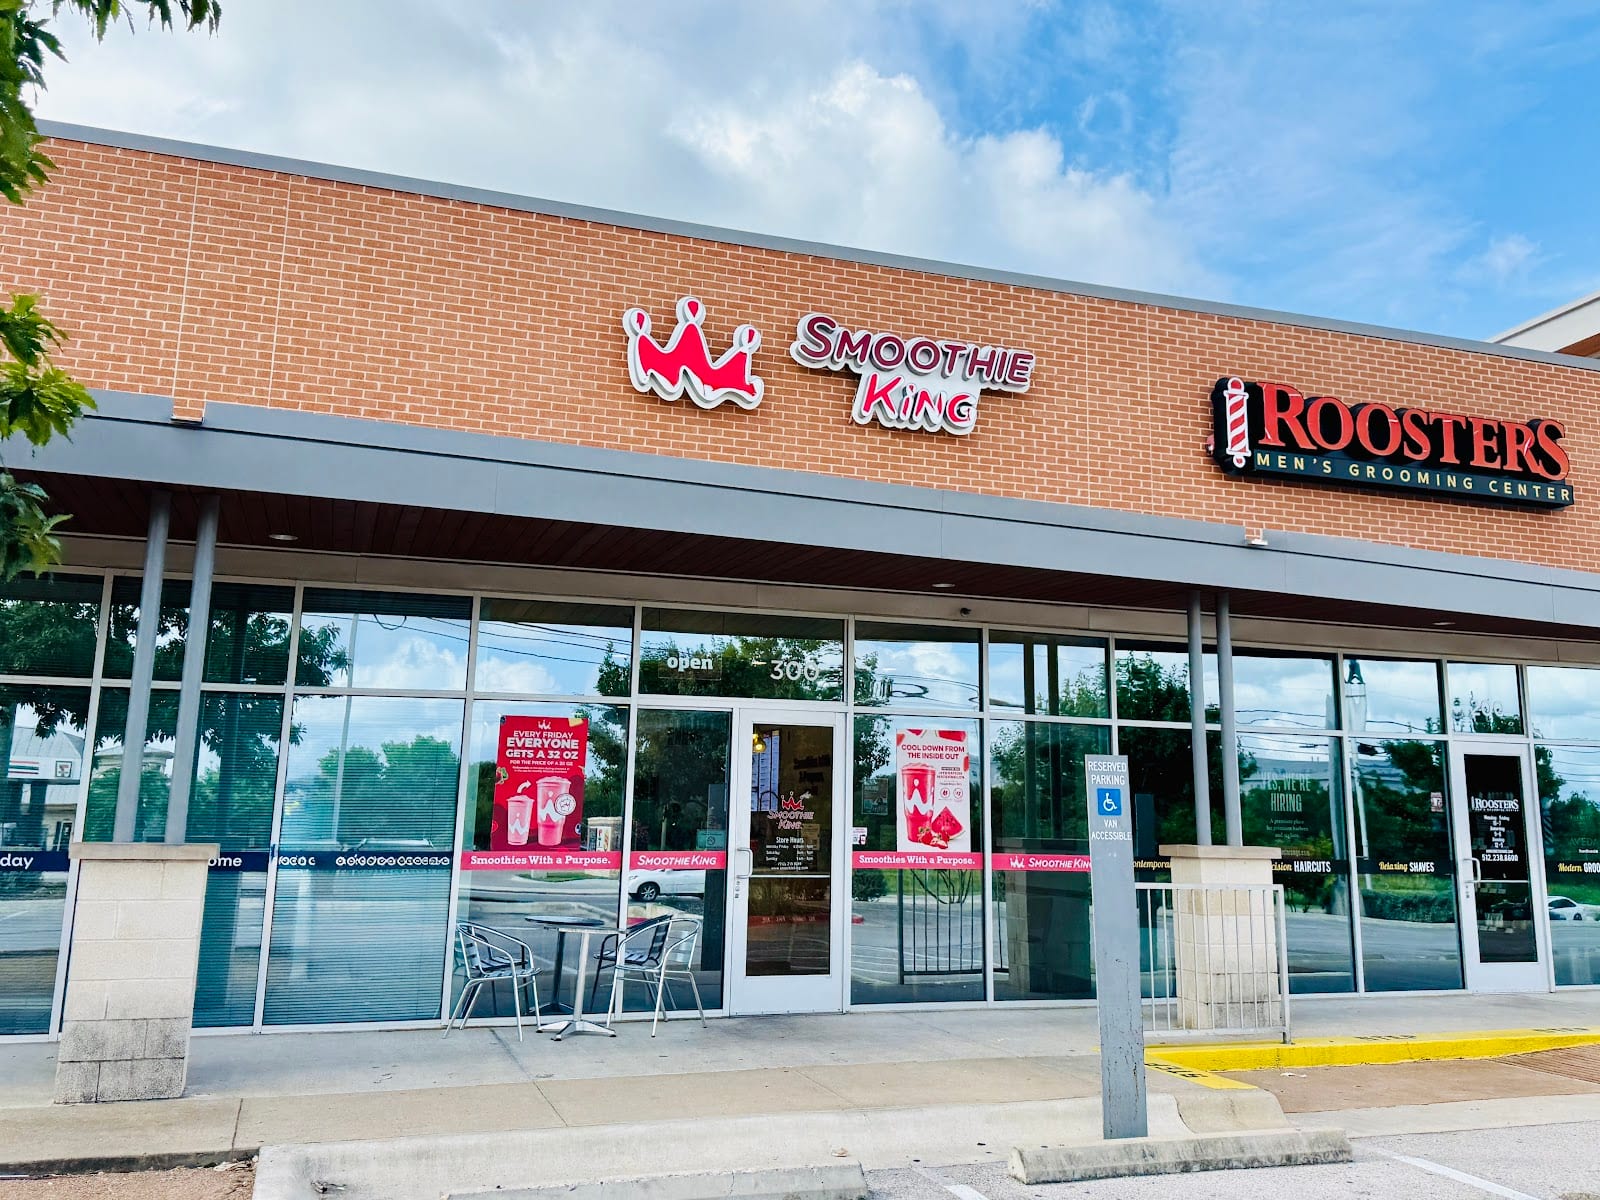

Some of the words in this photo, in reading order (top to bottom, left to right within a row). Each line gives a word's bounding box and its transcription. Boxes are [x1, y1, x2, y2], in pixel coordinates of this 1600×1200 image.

[799, 316, 1035, 384] SMOOTHIE
[1256, 381, 1570, 481] ROOSTERS
[1256, 452, 1332, 474] MEN'S
[1348, 463, 1474, 490] GROOMING
[1488, 480, 1571, 501] CENTER
[667, 655, 714, 672] open
[769, 659, 820, 682] 300
[513, 730, 541, 738] EVERY
[542, 731, 574, 739] FRIDAY
[506, 736, 579, 750] EVERYONE
[944, 745, 965, 753] FROM
[505, 748, 534, 758] GETS
[536, 750, 545, 759] A
[547, 750, 561, 759] 32
[562, 750, 579, 760] OZ
[1088, 760, 1127, 773] RESERVED
[1091, 774, 1126, 786] PARKING
[1270, 792, 1303, 813] HIRING
[1474, 797, 1520, 810] ROOSTERS
[1103, 819, 1118, 829] VAN
[775, 836, 789, 844] Store
[1091, 831, 1133, 841] ACCESSIBLE
[470, 855, 527, 865] Smoothies
[528, 855, 555, 865] With
[564, 856, 611, 866] Purpose.
[637, 854, 691, 866] SMOOTHIE
[859, 855, 906, 864] Smoothies
[906, 855, 928, 864] With
[936, 856, 976, 867] Purpose.
[1028, 857, 1073, 868] SMOOTHIE
[1293, 860, 1332, 873] HAIRCUTS
[1378, 860, 1408, 873] Relaxing
[1409, 861, 1435, 873] SHAVES
[1558, 862, 1583, 872] Modern
